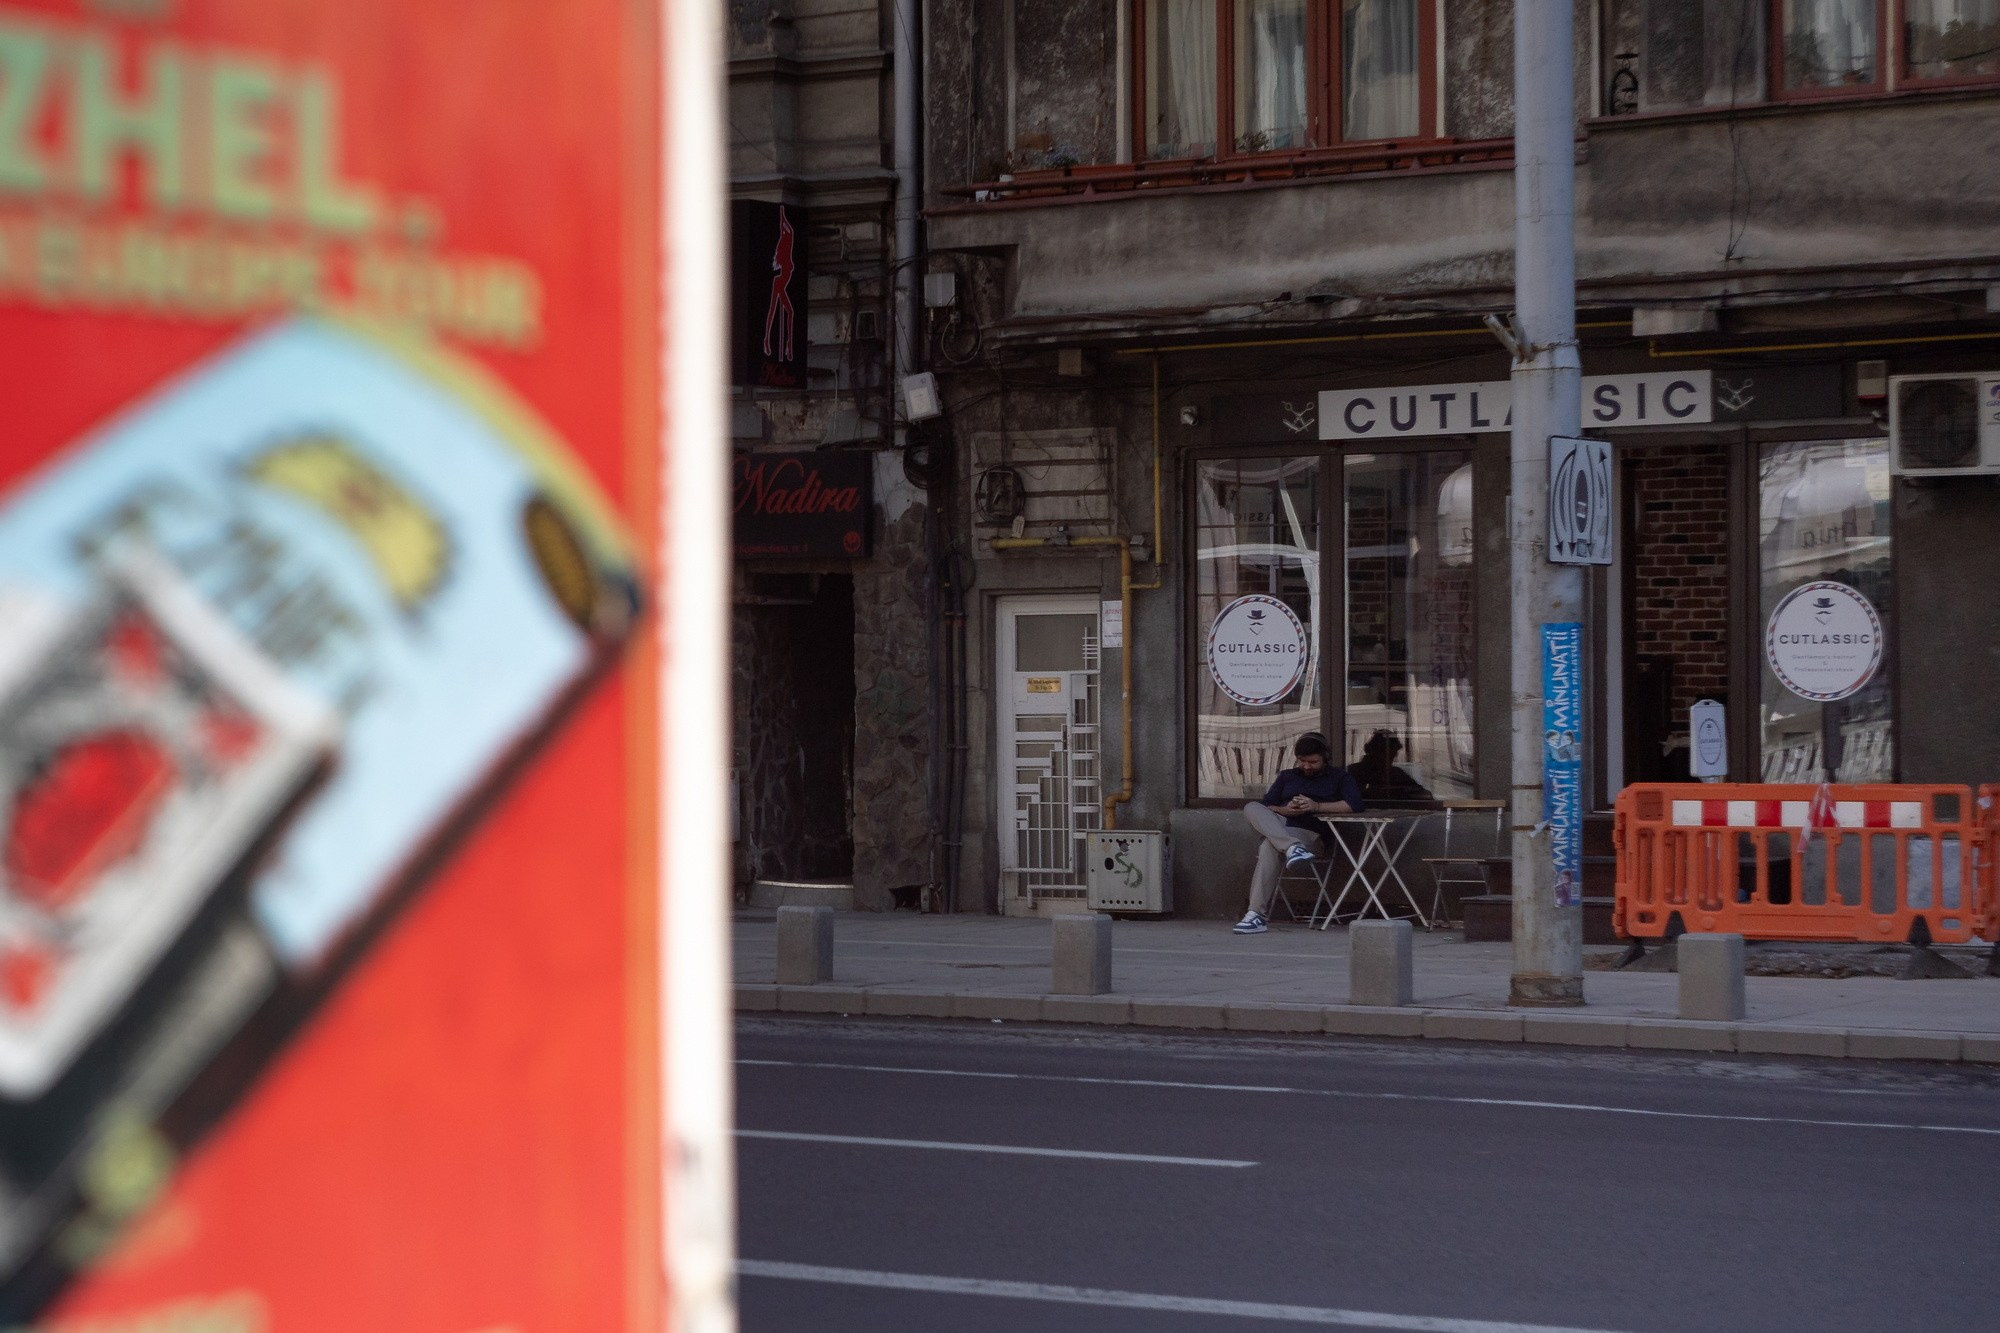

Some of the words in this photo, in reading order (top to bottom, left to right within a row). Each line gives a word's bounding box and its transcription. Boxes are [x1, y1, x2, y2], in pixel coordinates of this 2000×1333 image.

[1343, 381, 1697, 434] CUTLSIC
[733, 456, 860, 515] Nadira
[1218, 643, 1297, 653] CUTLASSIC
[1779, 634, 1871, 644] CUTLASSIC
[1571, 688, 1579, 716] SALA
[1571, 828, 1579, 855] SALA
